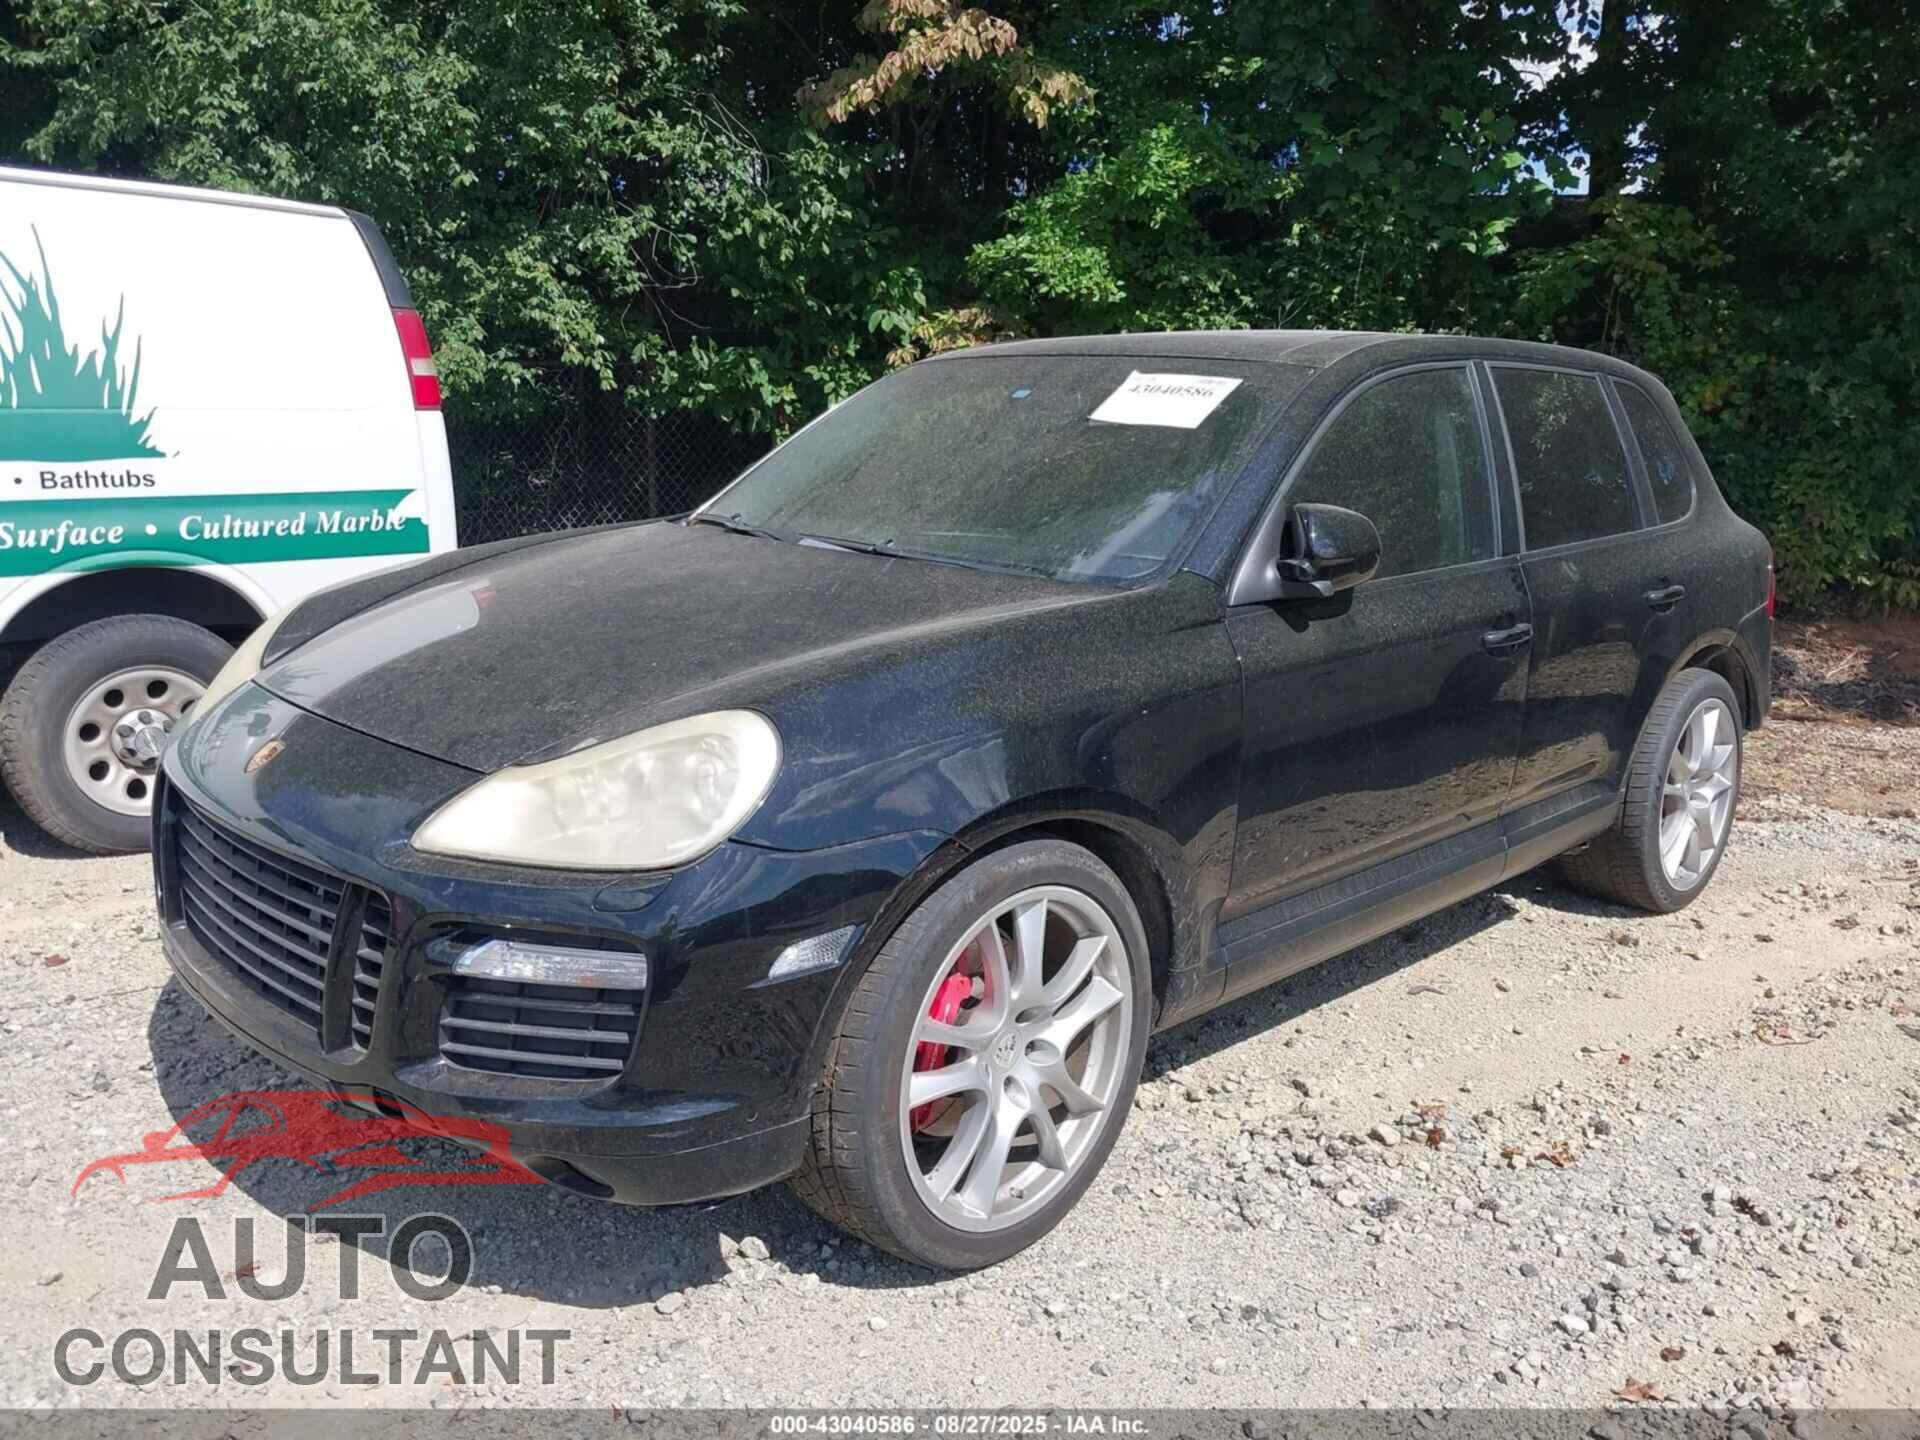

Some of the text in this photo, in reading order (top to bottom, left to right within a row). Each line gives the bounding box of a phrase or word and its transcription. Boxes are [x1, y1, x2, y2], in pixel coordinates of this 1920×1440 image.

[1128, 384, 1214, 398] 43040586
[39, 469, 156, 490] Bathtubs
[0, 508, 406, 554] Surface Cultured Marble
